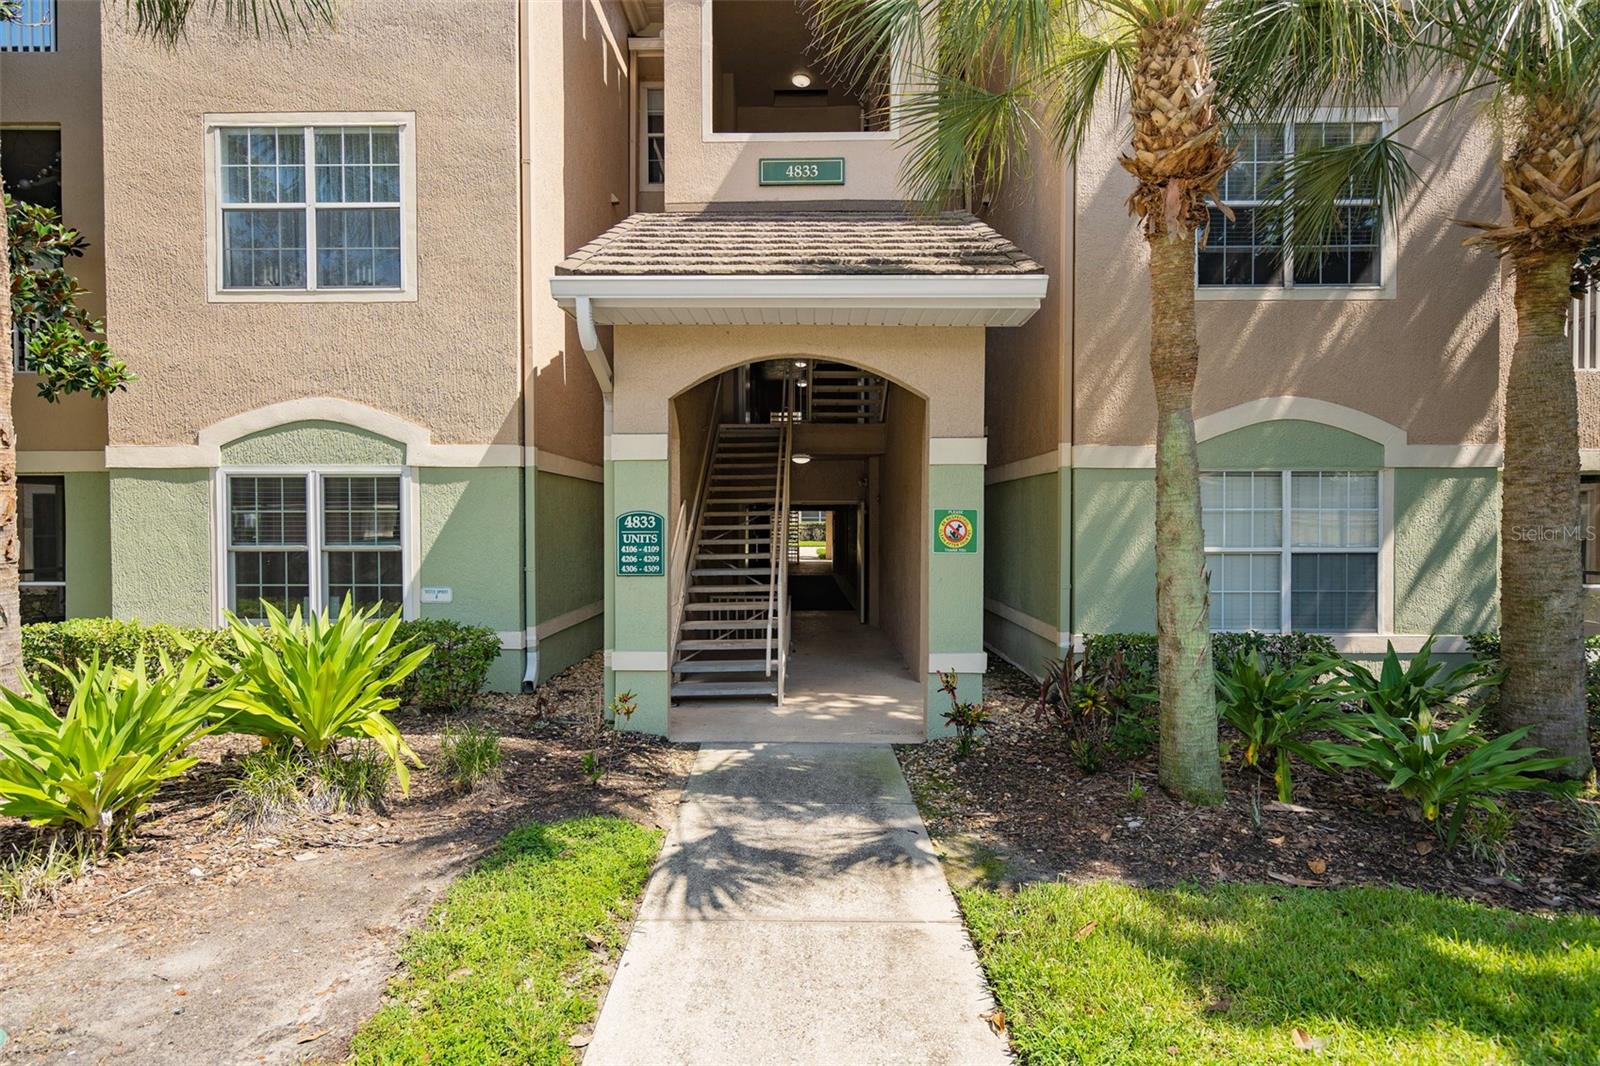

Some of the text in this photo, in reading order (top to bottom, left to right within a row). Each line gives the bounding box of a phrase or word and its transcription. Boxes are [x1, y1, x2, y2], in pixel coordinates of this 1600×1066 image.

[785, 164, 819, 178] 4833
[624, 515, 656, 528] 4833
[622, 534, 658, 543] UNITS
